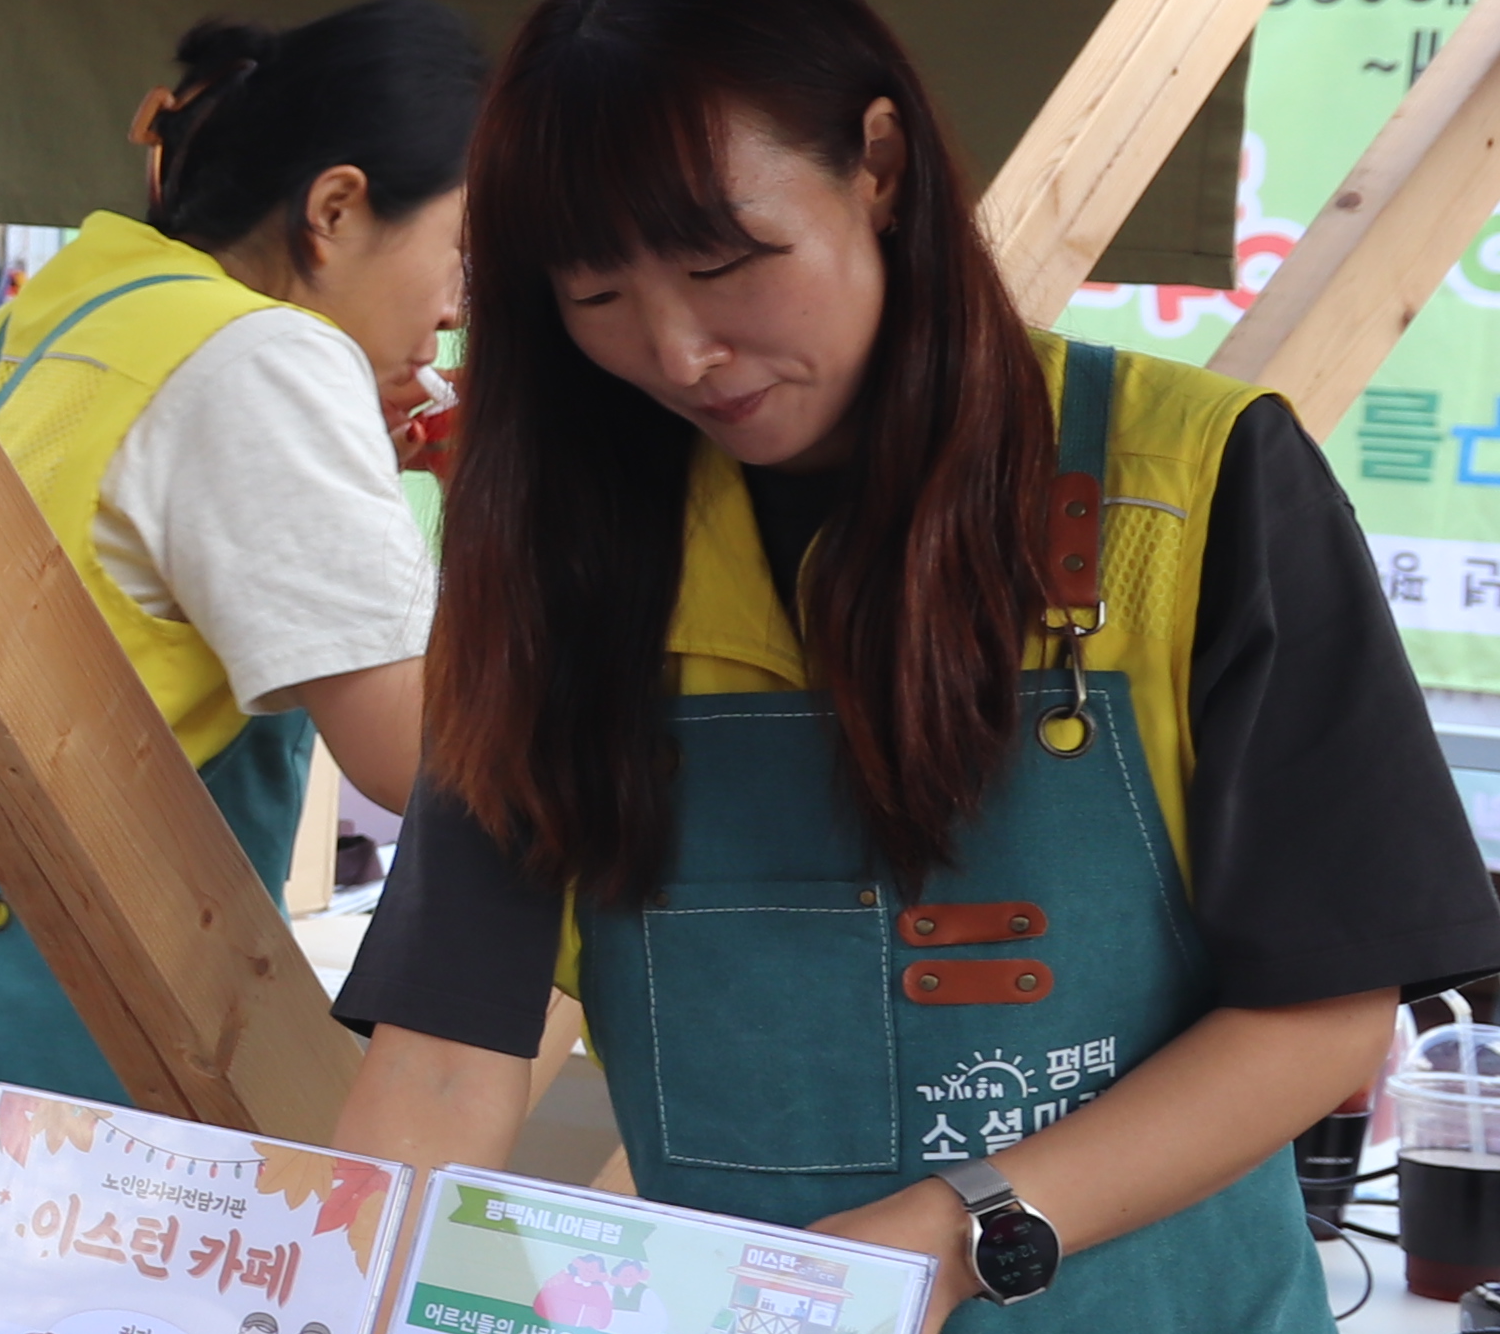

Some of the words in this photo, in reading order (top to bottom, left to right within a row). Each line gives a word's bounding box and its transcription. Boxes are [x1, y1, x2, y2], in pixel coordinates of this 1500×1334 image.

[1046, 1035, 1117, 1091] 평택
[101, 1172, 248, 1219] 노인일자리전담기관
[484, 1196, 624, 1247] 평택시니어클럽
[30, 1192, 182, 1282] 이스턴
[186, 1228, 303, 1310] 카페
[746, 1247, 800, 1274] 이스턴
